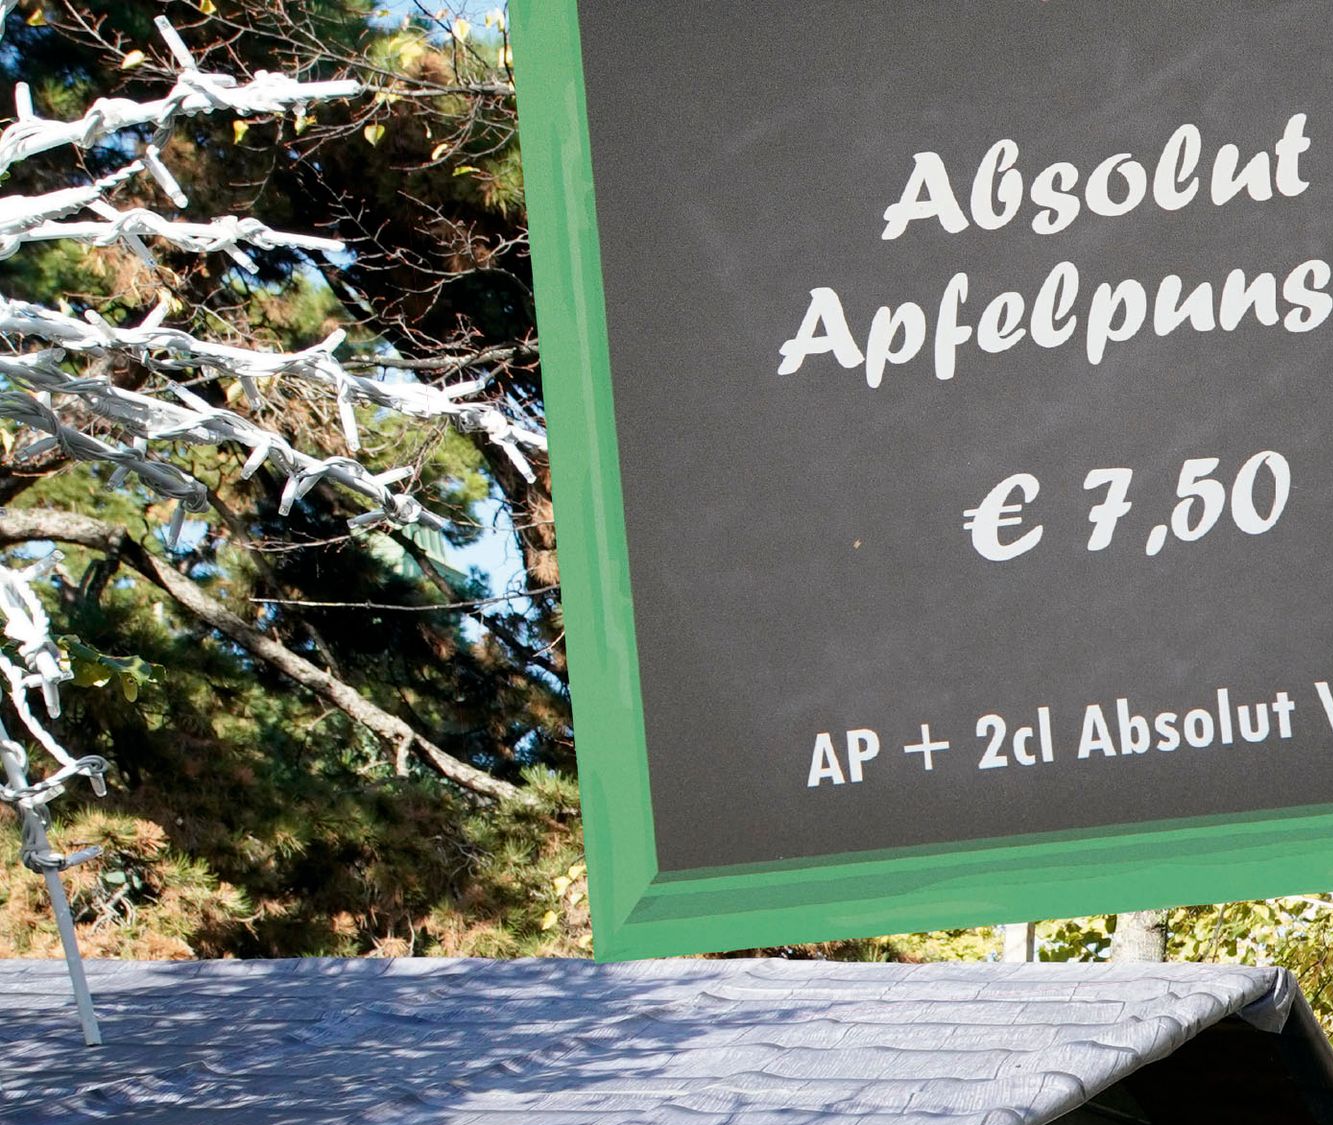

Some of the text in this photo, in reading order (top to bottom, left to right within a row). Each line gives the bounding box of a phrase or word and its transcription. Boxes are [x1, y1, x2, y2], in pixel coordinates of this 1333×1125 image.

[881, 112, 1312, 241] Absolut
[962, 450, 1291, 562] € 7,50
[807, 728, 880, 788] AP
[903, 723, 950, 771] +
[975, 706, 1054, 770] 2cl
[1077, 687, 1296, 759] Absolut
